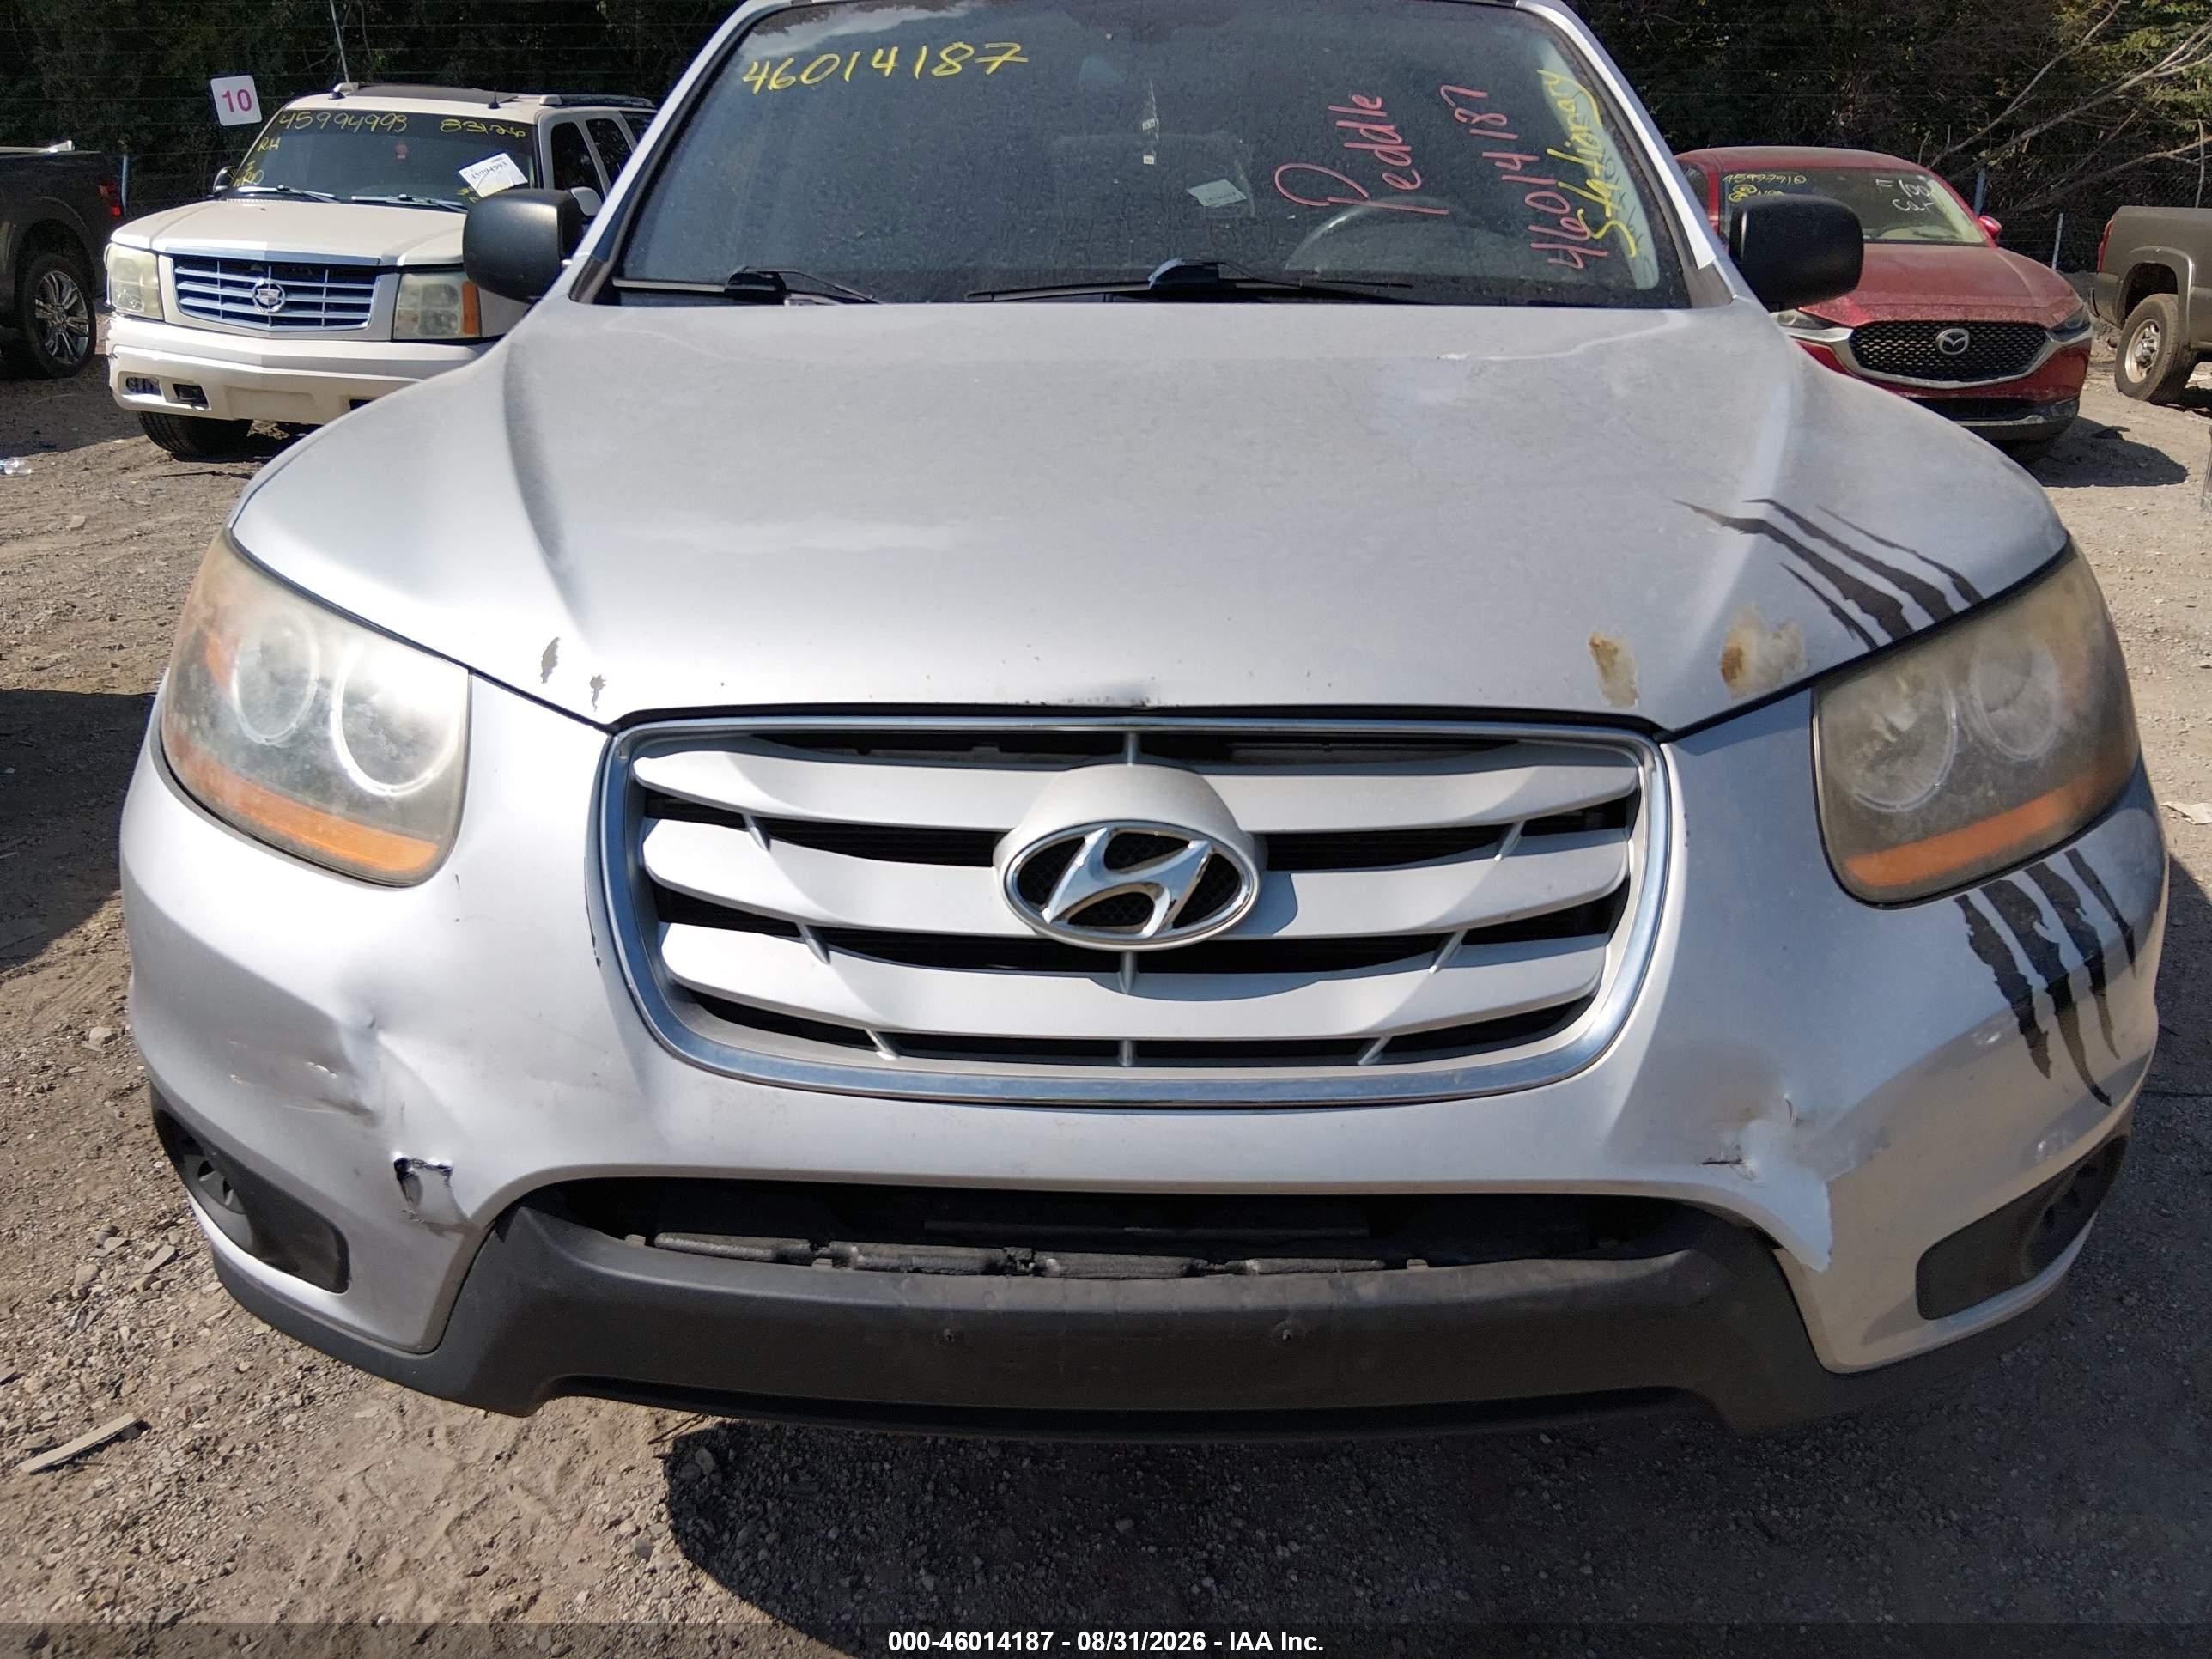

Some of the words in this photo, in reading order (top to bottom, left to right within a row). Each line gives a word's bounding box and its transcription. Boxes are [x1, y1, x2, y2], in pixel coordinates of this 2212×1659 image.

[222, 88, 252, 112] 10
[741, 41, 1029, 94] 46014187
[1274, 93, 1449, 215] Peddle
[1440, 85, 1608, 269] 46014187
